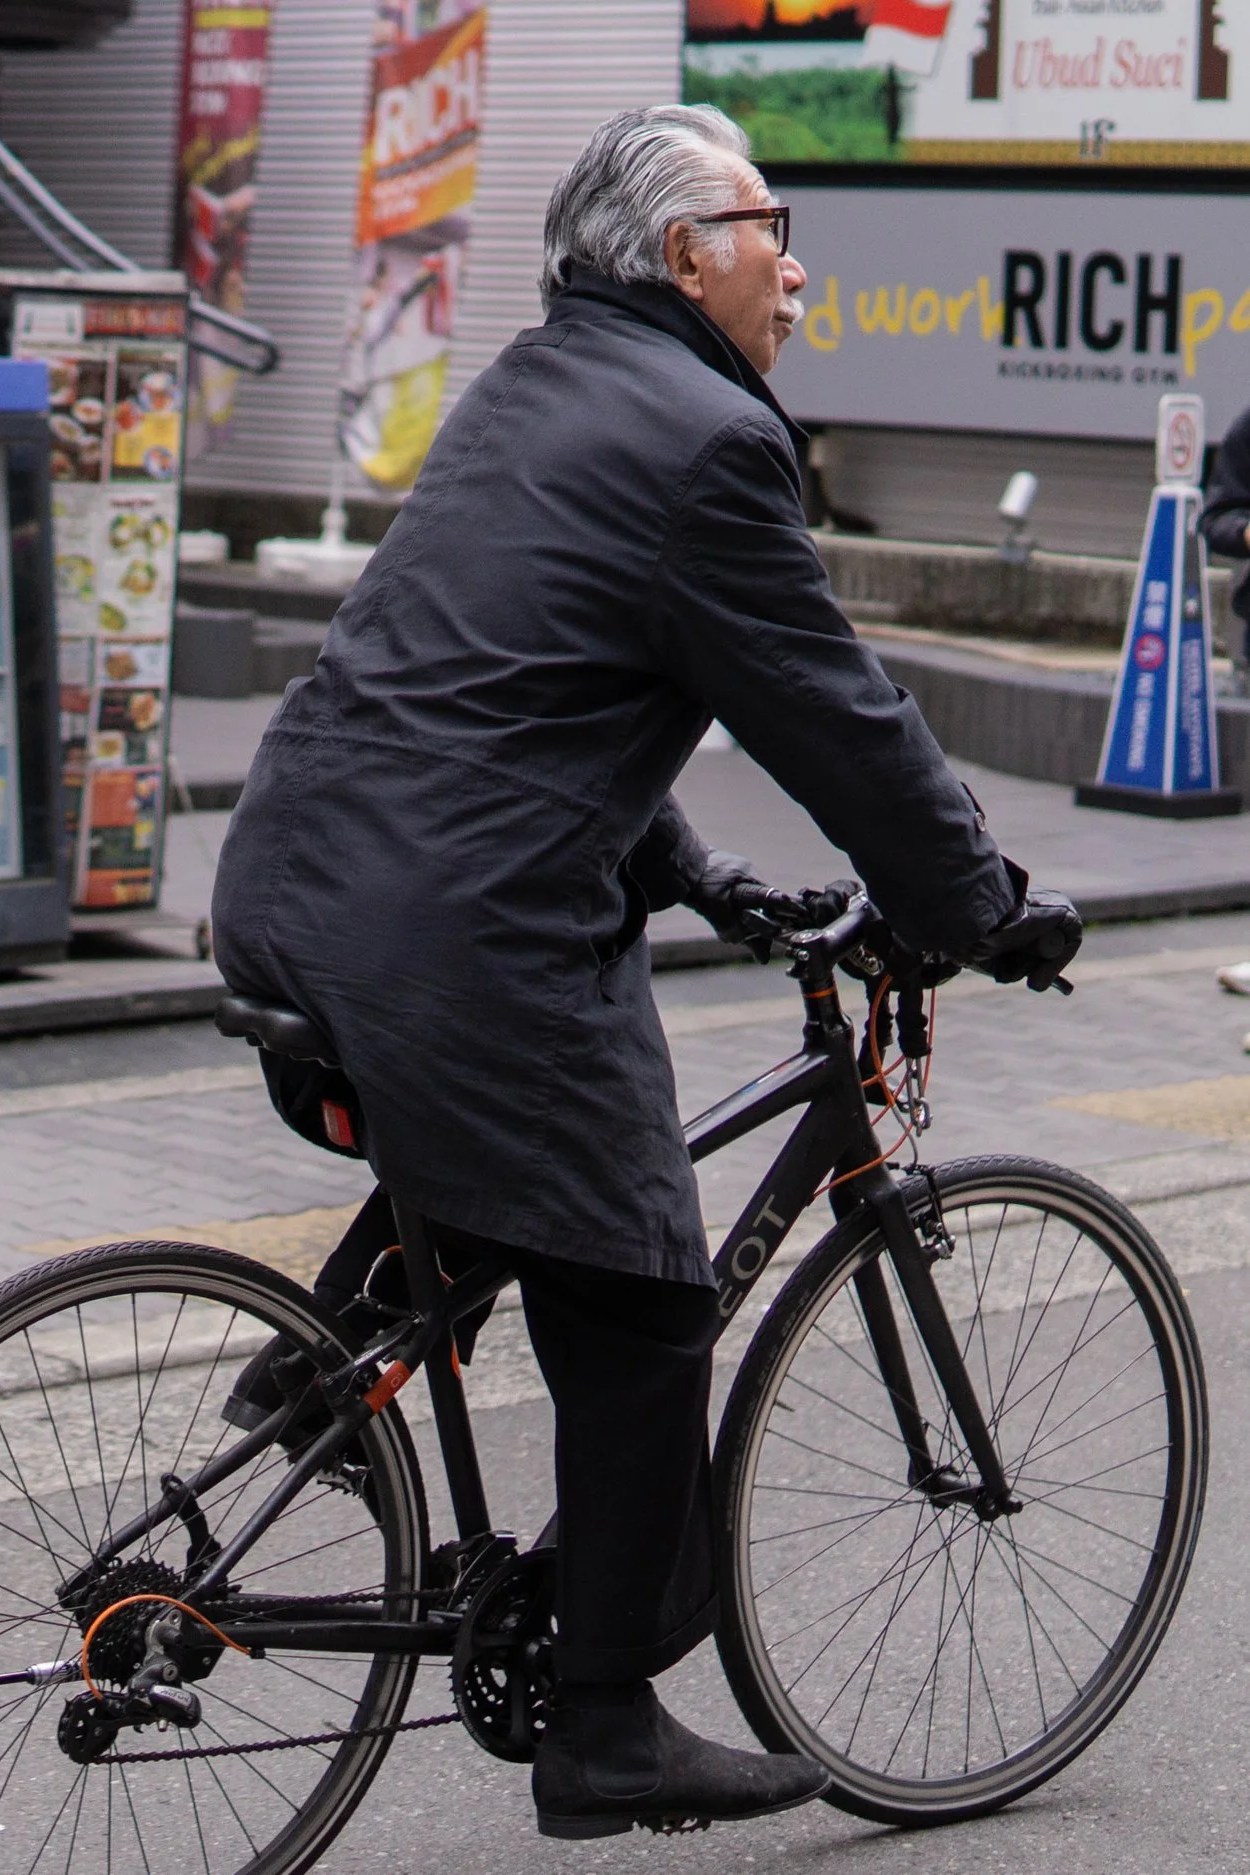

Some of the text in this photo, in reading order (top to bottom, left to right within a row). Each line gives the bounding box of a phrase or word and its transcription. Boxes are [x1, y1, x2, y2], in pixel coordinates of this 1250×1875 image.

[373, 48, 480, 164] RICH
[1012, 37, 1187, 89] Ubud Suci
[1001, 247, 1184, 355] RICH
